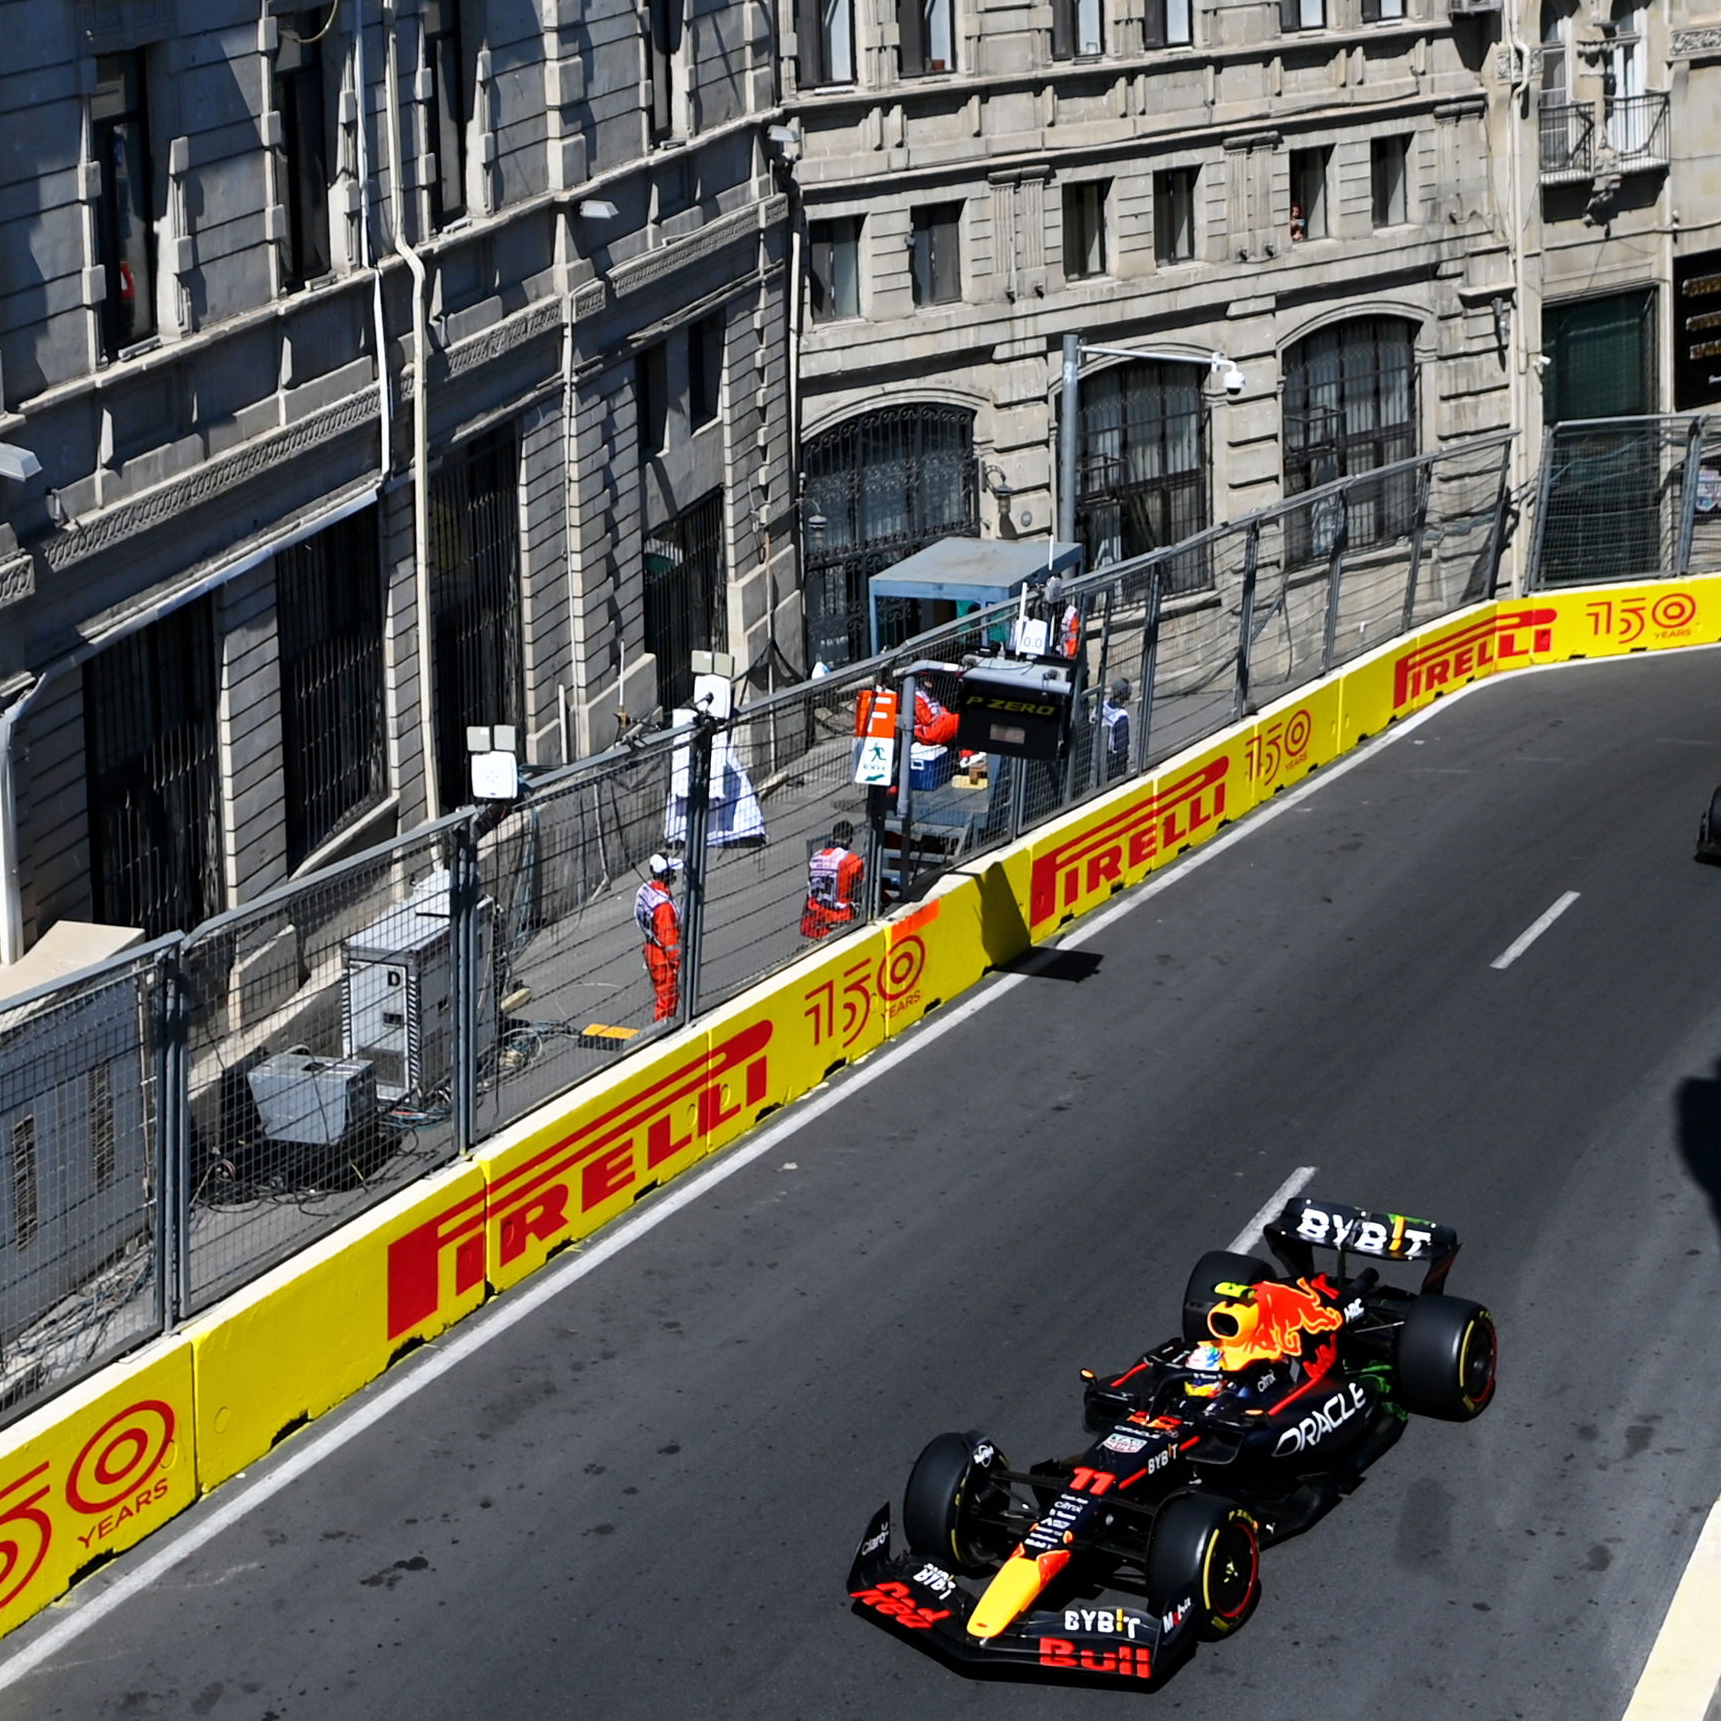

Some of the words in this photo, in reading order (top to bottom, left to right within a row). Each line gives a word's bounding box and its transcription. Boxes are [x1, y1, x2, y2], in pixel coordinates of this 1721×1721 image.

[1393, 607, 1558, 710] PIRELLI
[987, 698, 1056, 716] ZERO
[1030, 755, 1230, 929] PIRELLI
[387, 970, 401, 987] D
[387, 1019, 774, 1342] PIRELLI
[1296, 1207, 1432, 1256] BYBIT
[1271, 1382, 1366, 1458] ORACLE
[1069, 1466, 1117, 1496] 11
[1148, 1443, 1178, 1475] BYBIT
[77, 1478, 169, 1551] YEARS
[1064, 1608, 1142, 1639] BYBIT
[1039, 1636, 1151, 1679] Bull
